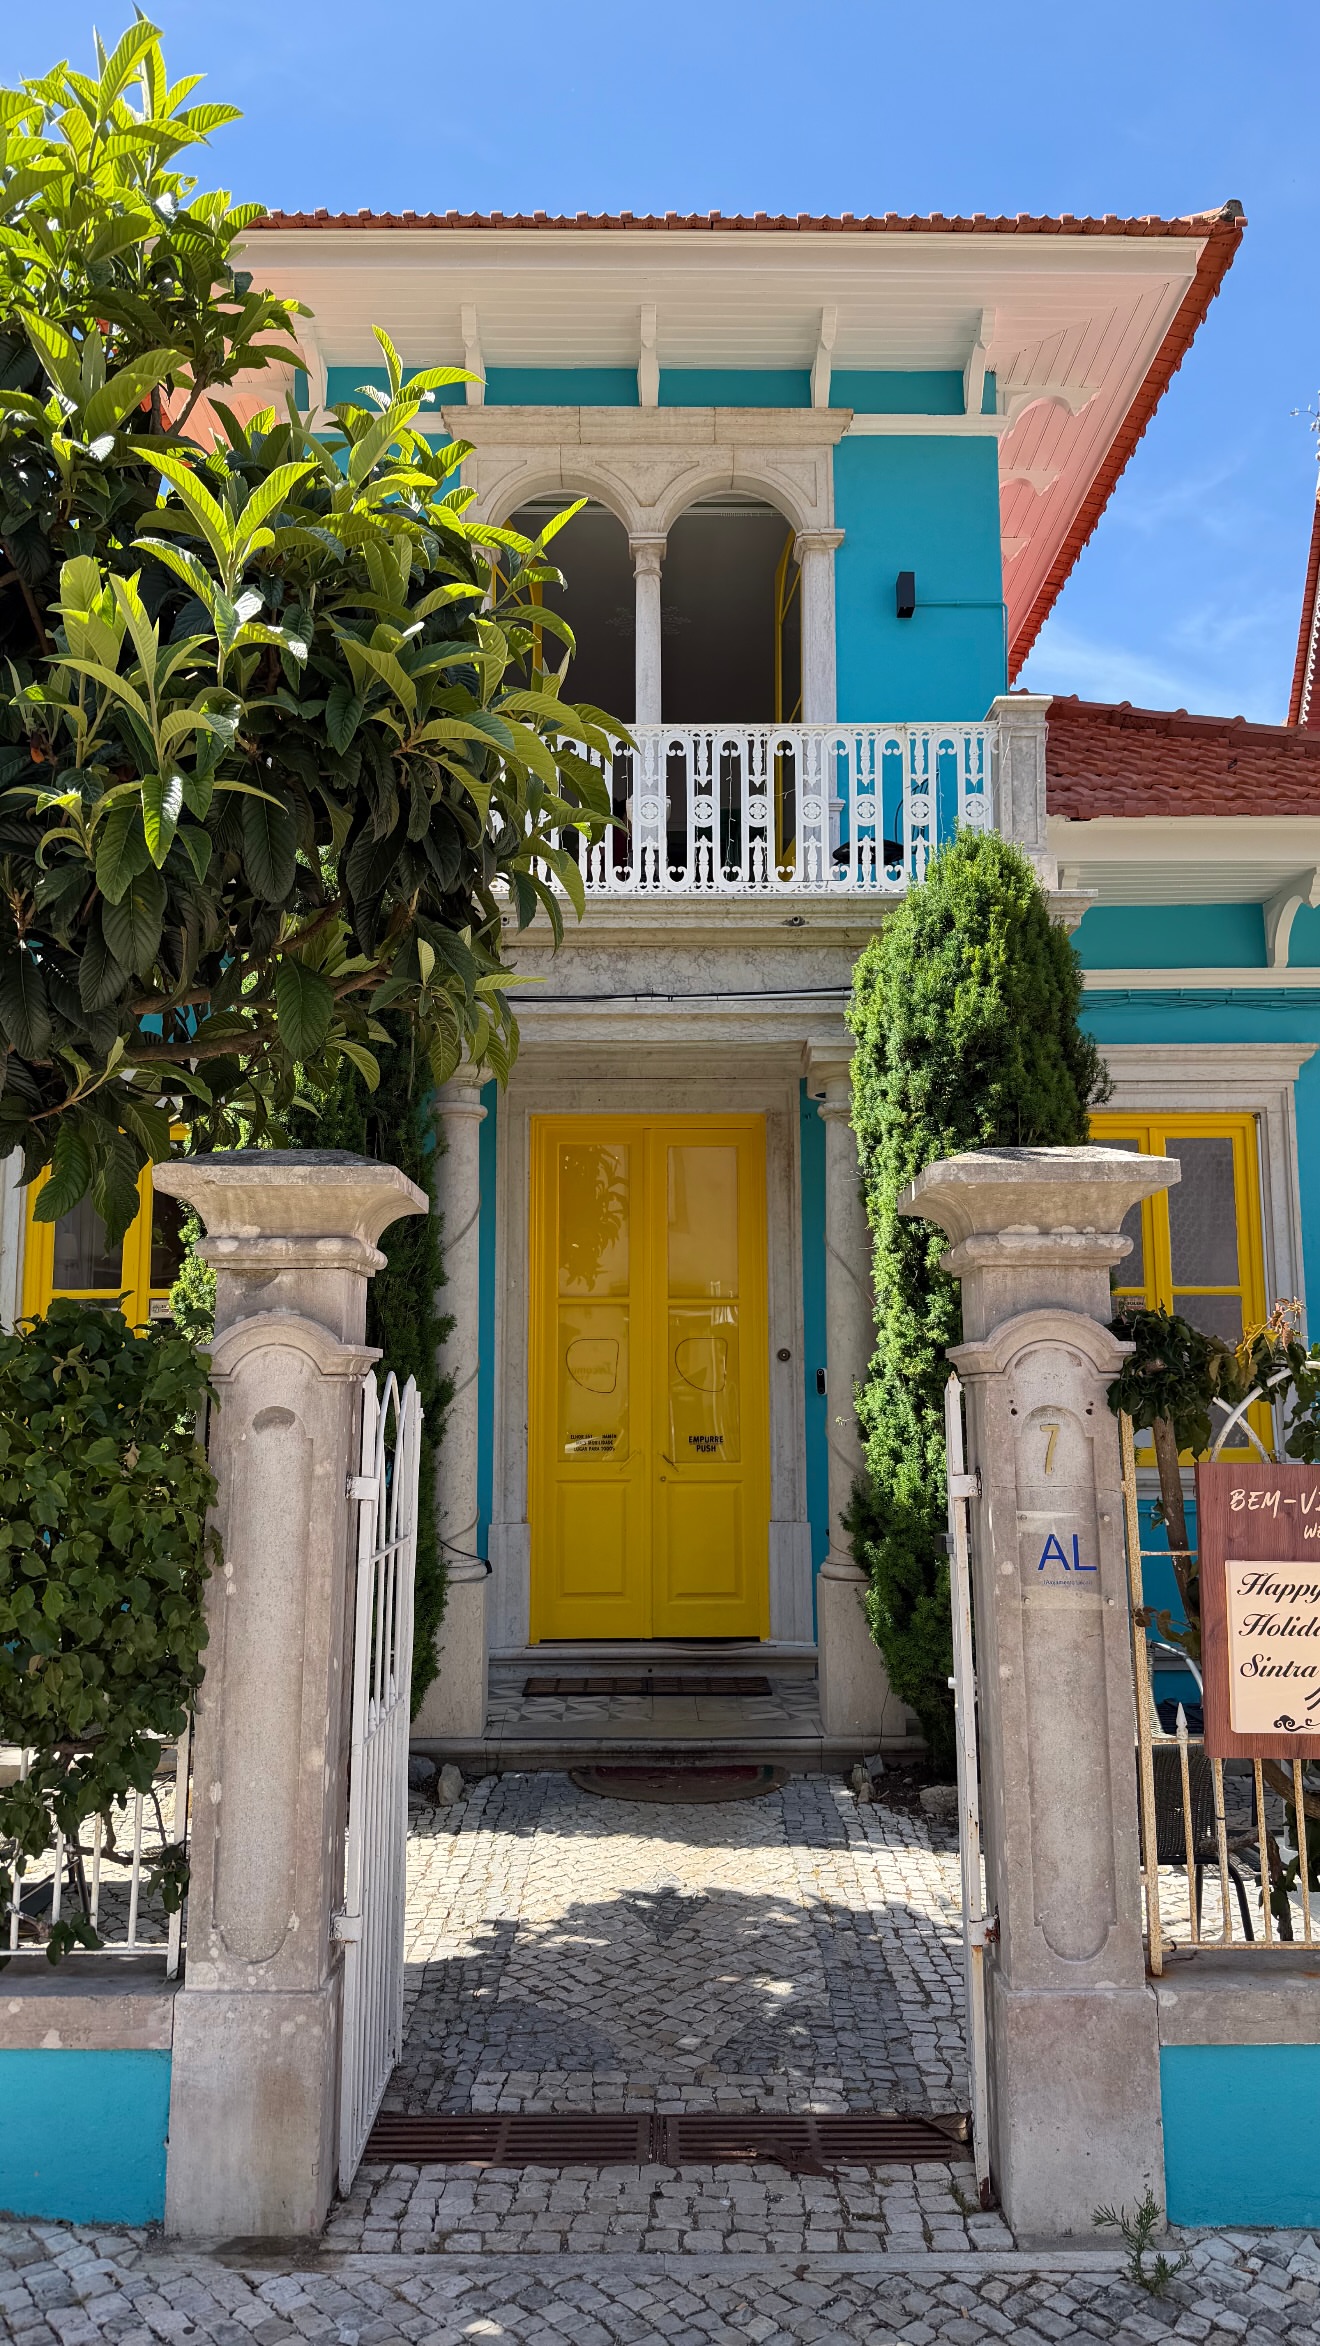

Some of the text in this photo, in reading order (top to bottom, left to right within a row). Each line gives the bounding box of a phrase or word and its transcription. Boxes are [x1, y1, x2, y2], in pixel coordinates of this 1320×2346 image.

[688, 1435, 724, 1443] EMPURRE
[1040, 1423, 1060, 1475] 7
[1037, 1533, 1098, 1571] AL
[1236, 1572, 1320, 1604] Happy
[1240, 1653, 1318, 1679] Sintra
